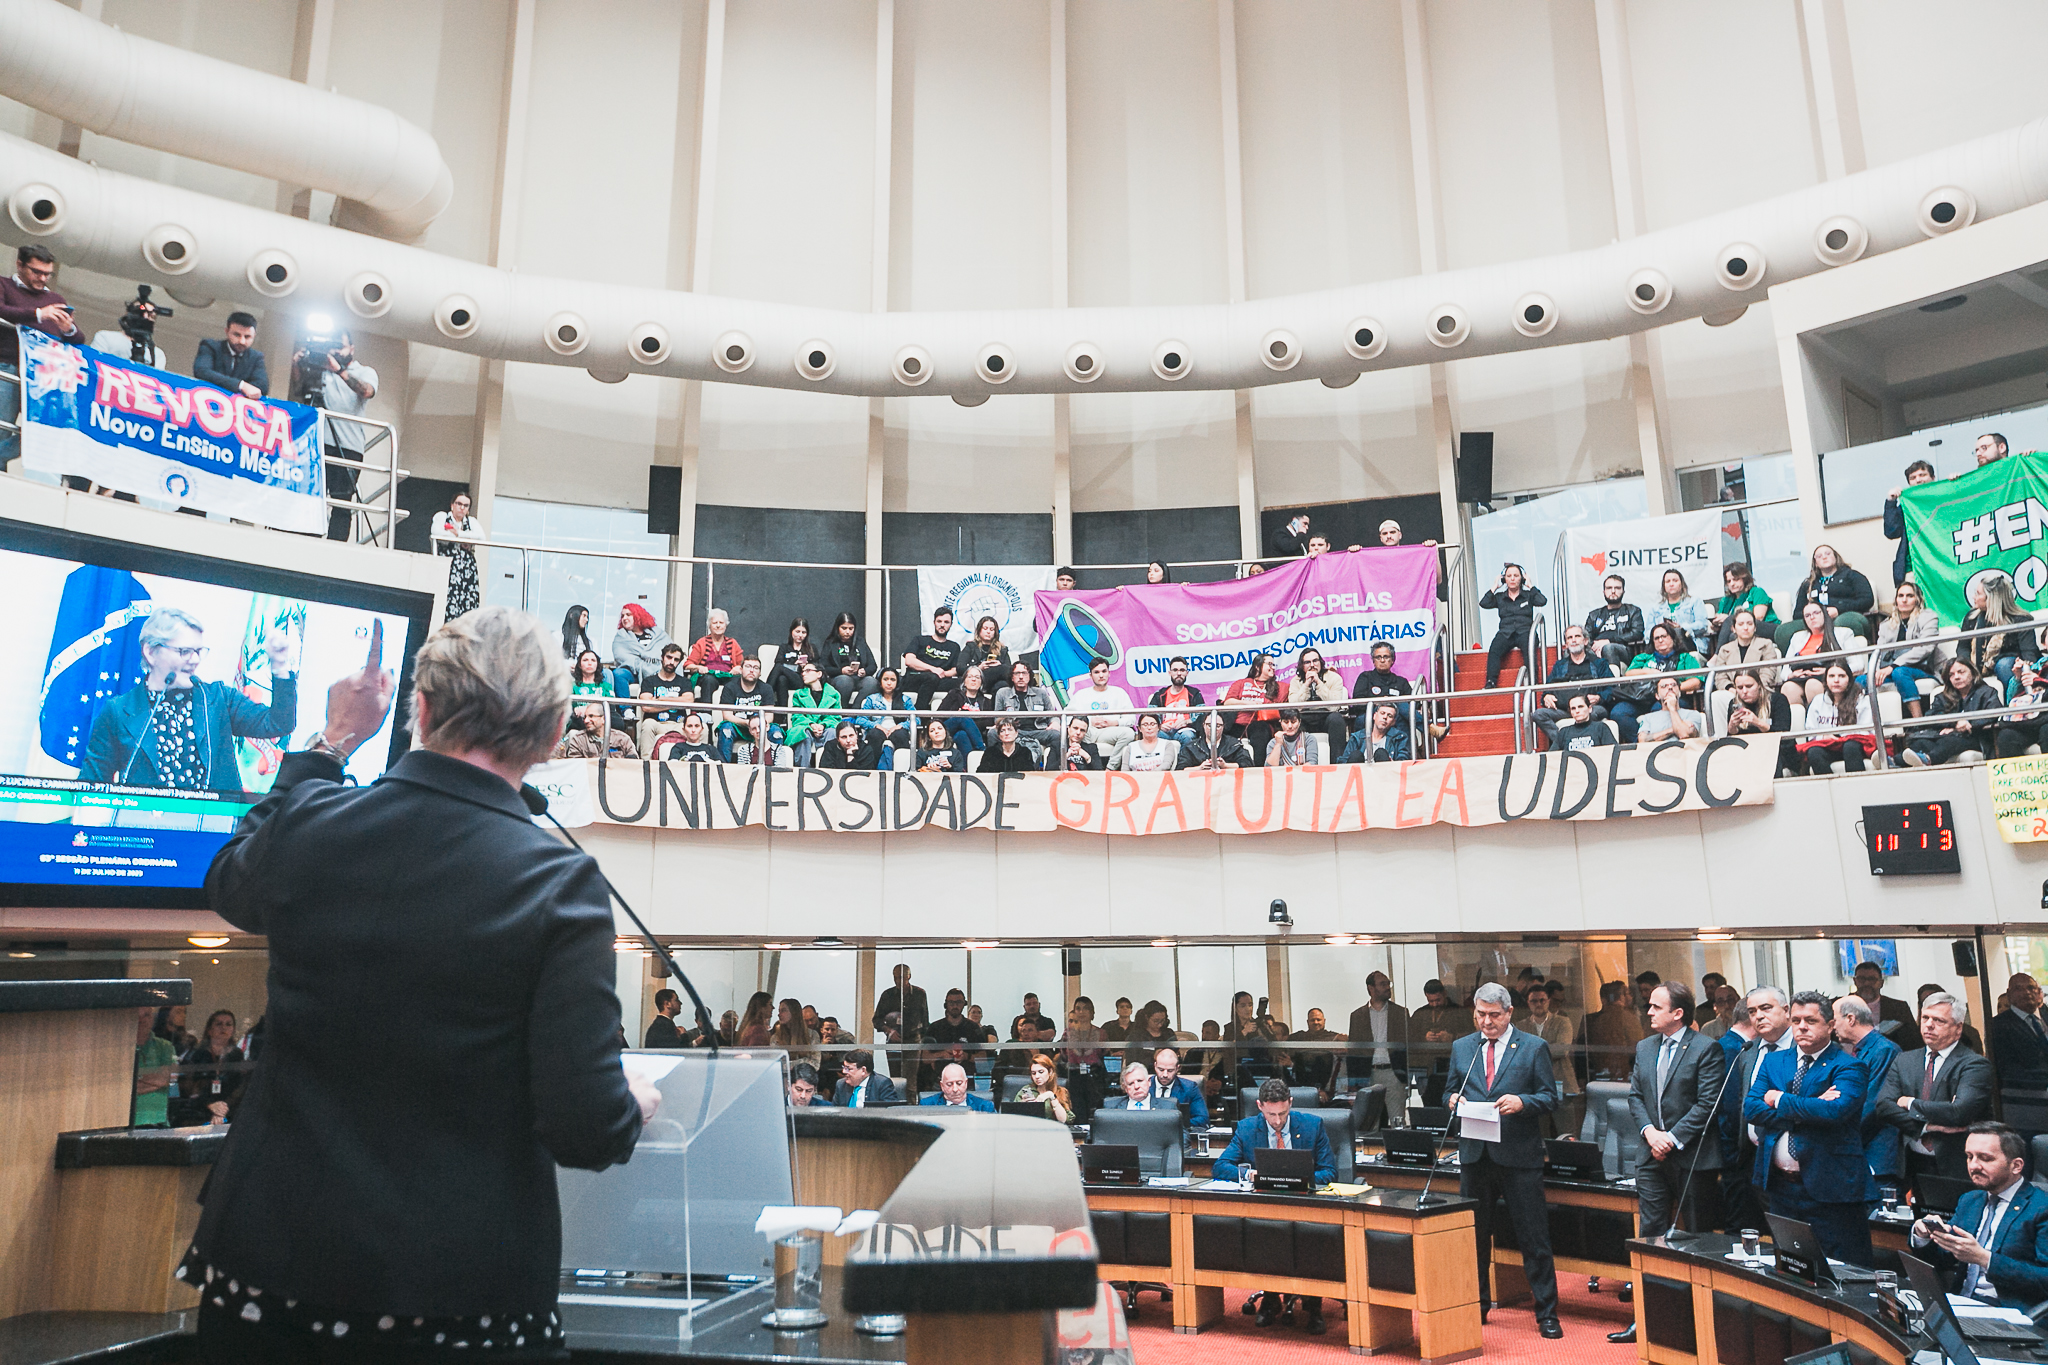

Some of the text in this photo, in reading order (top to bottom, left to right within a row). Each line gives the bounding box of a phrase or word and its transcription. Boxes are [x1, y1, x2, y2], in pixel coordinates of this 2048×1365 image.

[89, 400, 304, 482] Novo Ensino Médio
[1608, 542, 1709, 568] SINTESPE
[953, 573, 983, 597] REGIONAL
[984, 573, 1023, 613] FLORIANÓPOLIS
[1176, 591, 1393, 643] SOMOS TODOS PELAS
[1283, 620, 1426, 654] COMUNITÁRIAS
[600, 758, 1026, 831] UNIVERSIDADE
[1049, 764, 1368, 835] GRATUITA
[1499, 737, 1749, 822] UDESC
[1993, 763, 2008, 776] SC
[2011, 762, 2034, 772] TEM
[1996, 806, 2038, 820] SOFREM
[2014, 824, 2028, 833] DE
